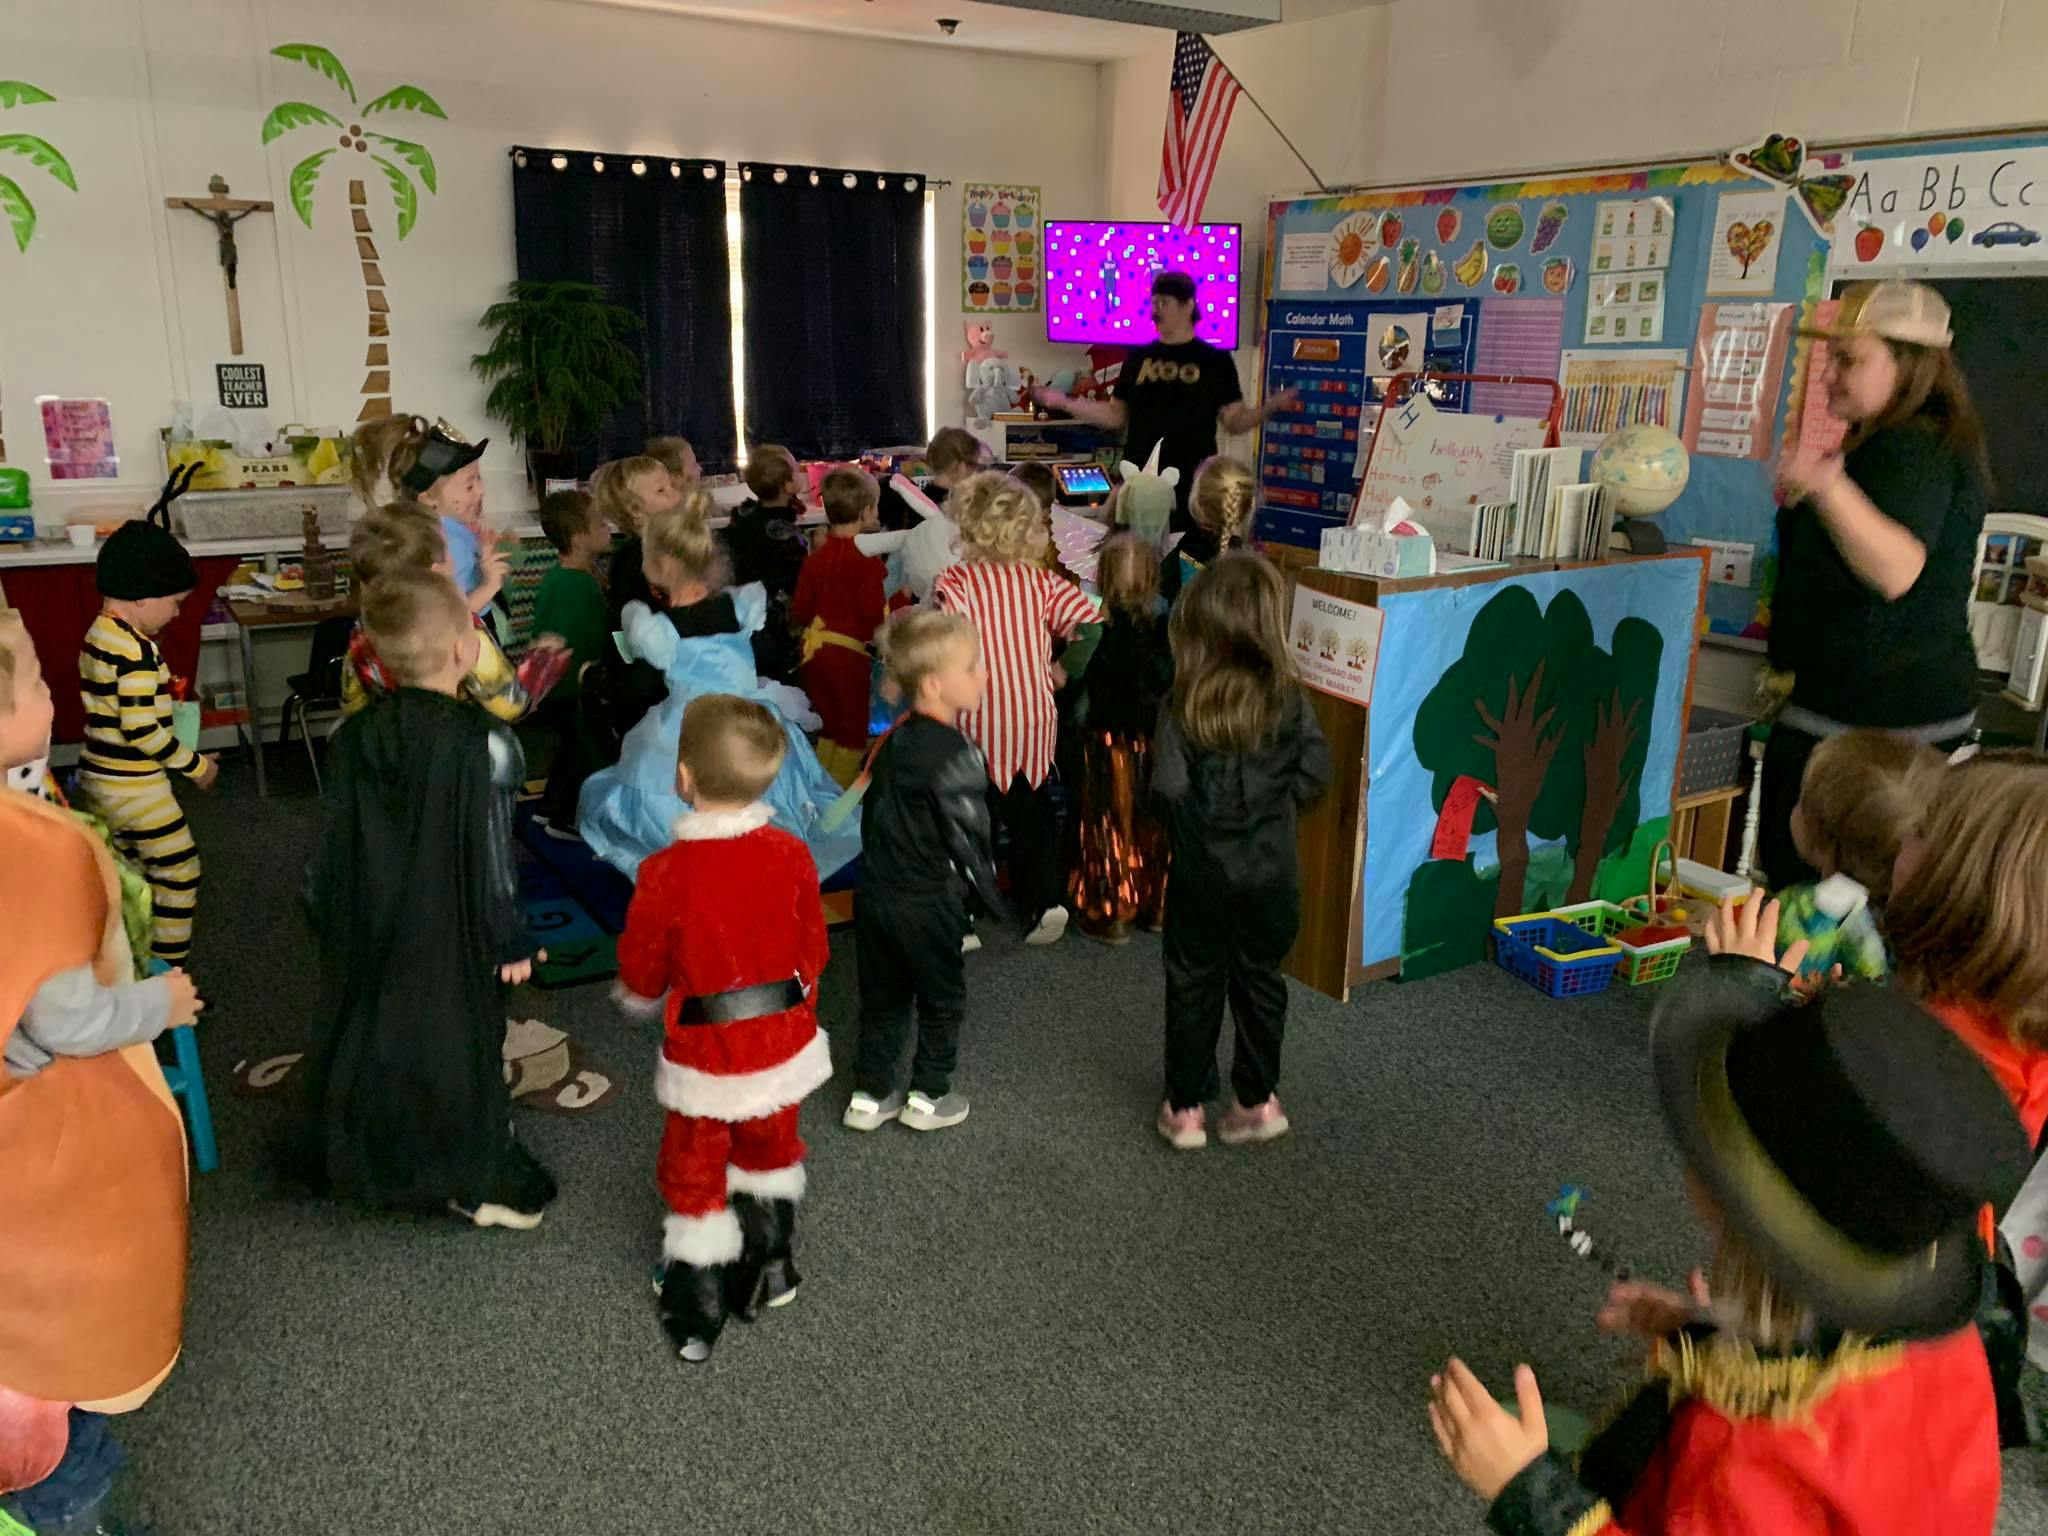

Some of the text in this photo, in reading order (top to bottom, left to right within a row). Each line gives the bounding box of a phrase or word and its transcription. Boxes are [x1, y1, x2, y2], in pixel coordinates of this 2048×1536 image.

[1286, 312, 1354, 325] Calendar Math
[221, 367, 261, 380] COOLEST
[223, 381, 262, 391] TEACHER
[224, 392, 265, 406] EVER
[242, 464, 289, 473] PEARS
[1312, 598, 1357, 621] WELCOME!
